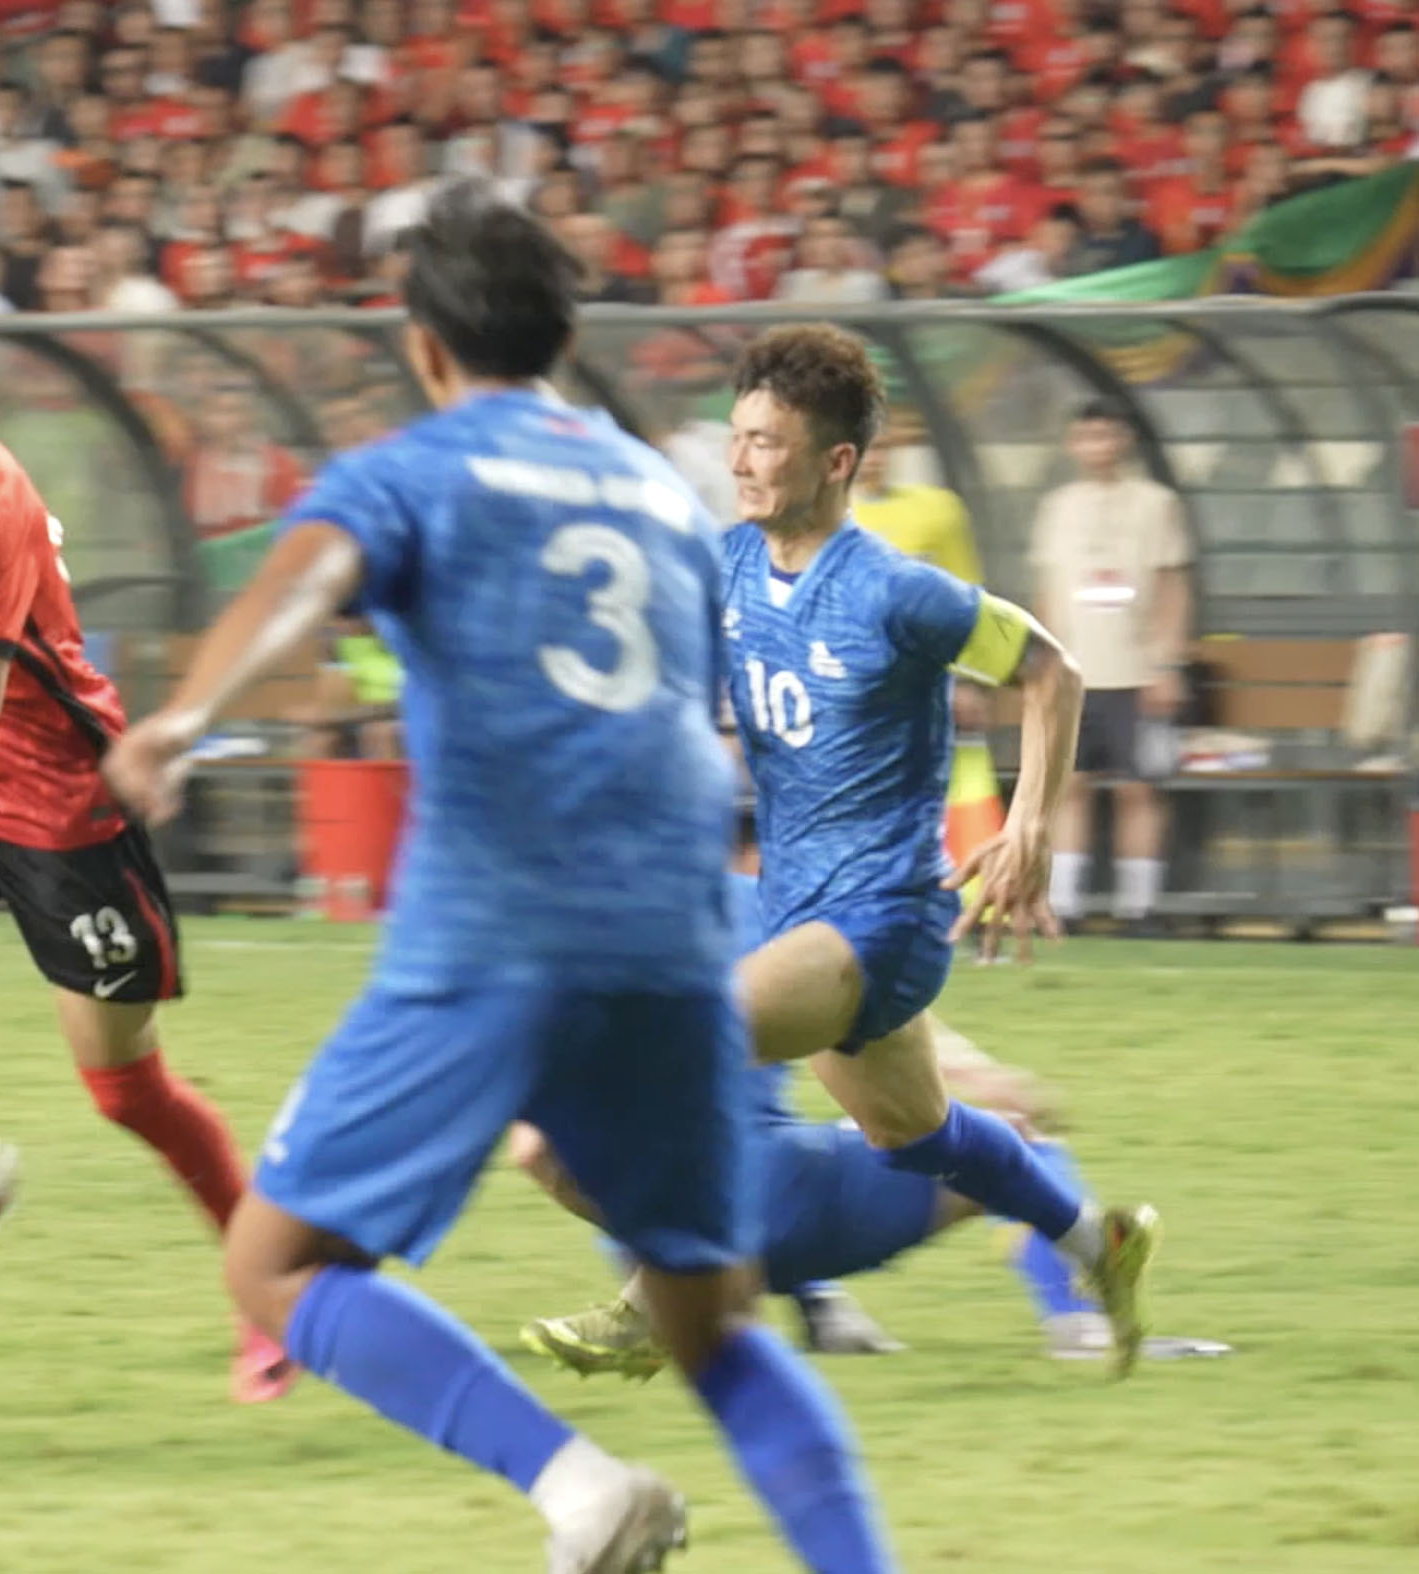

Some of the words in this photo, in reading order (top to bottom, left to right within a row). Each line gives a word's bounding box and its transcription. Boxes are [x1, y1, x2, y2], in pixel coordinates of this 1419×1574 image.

[538, 522, 658, 713] 3
[744, 656, 815, 748] 10
[70, 905, 138, 969] 13
